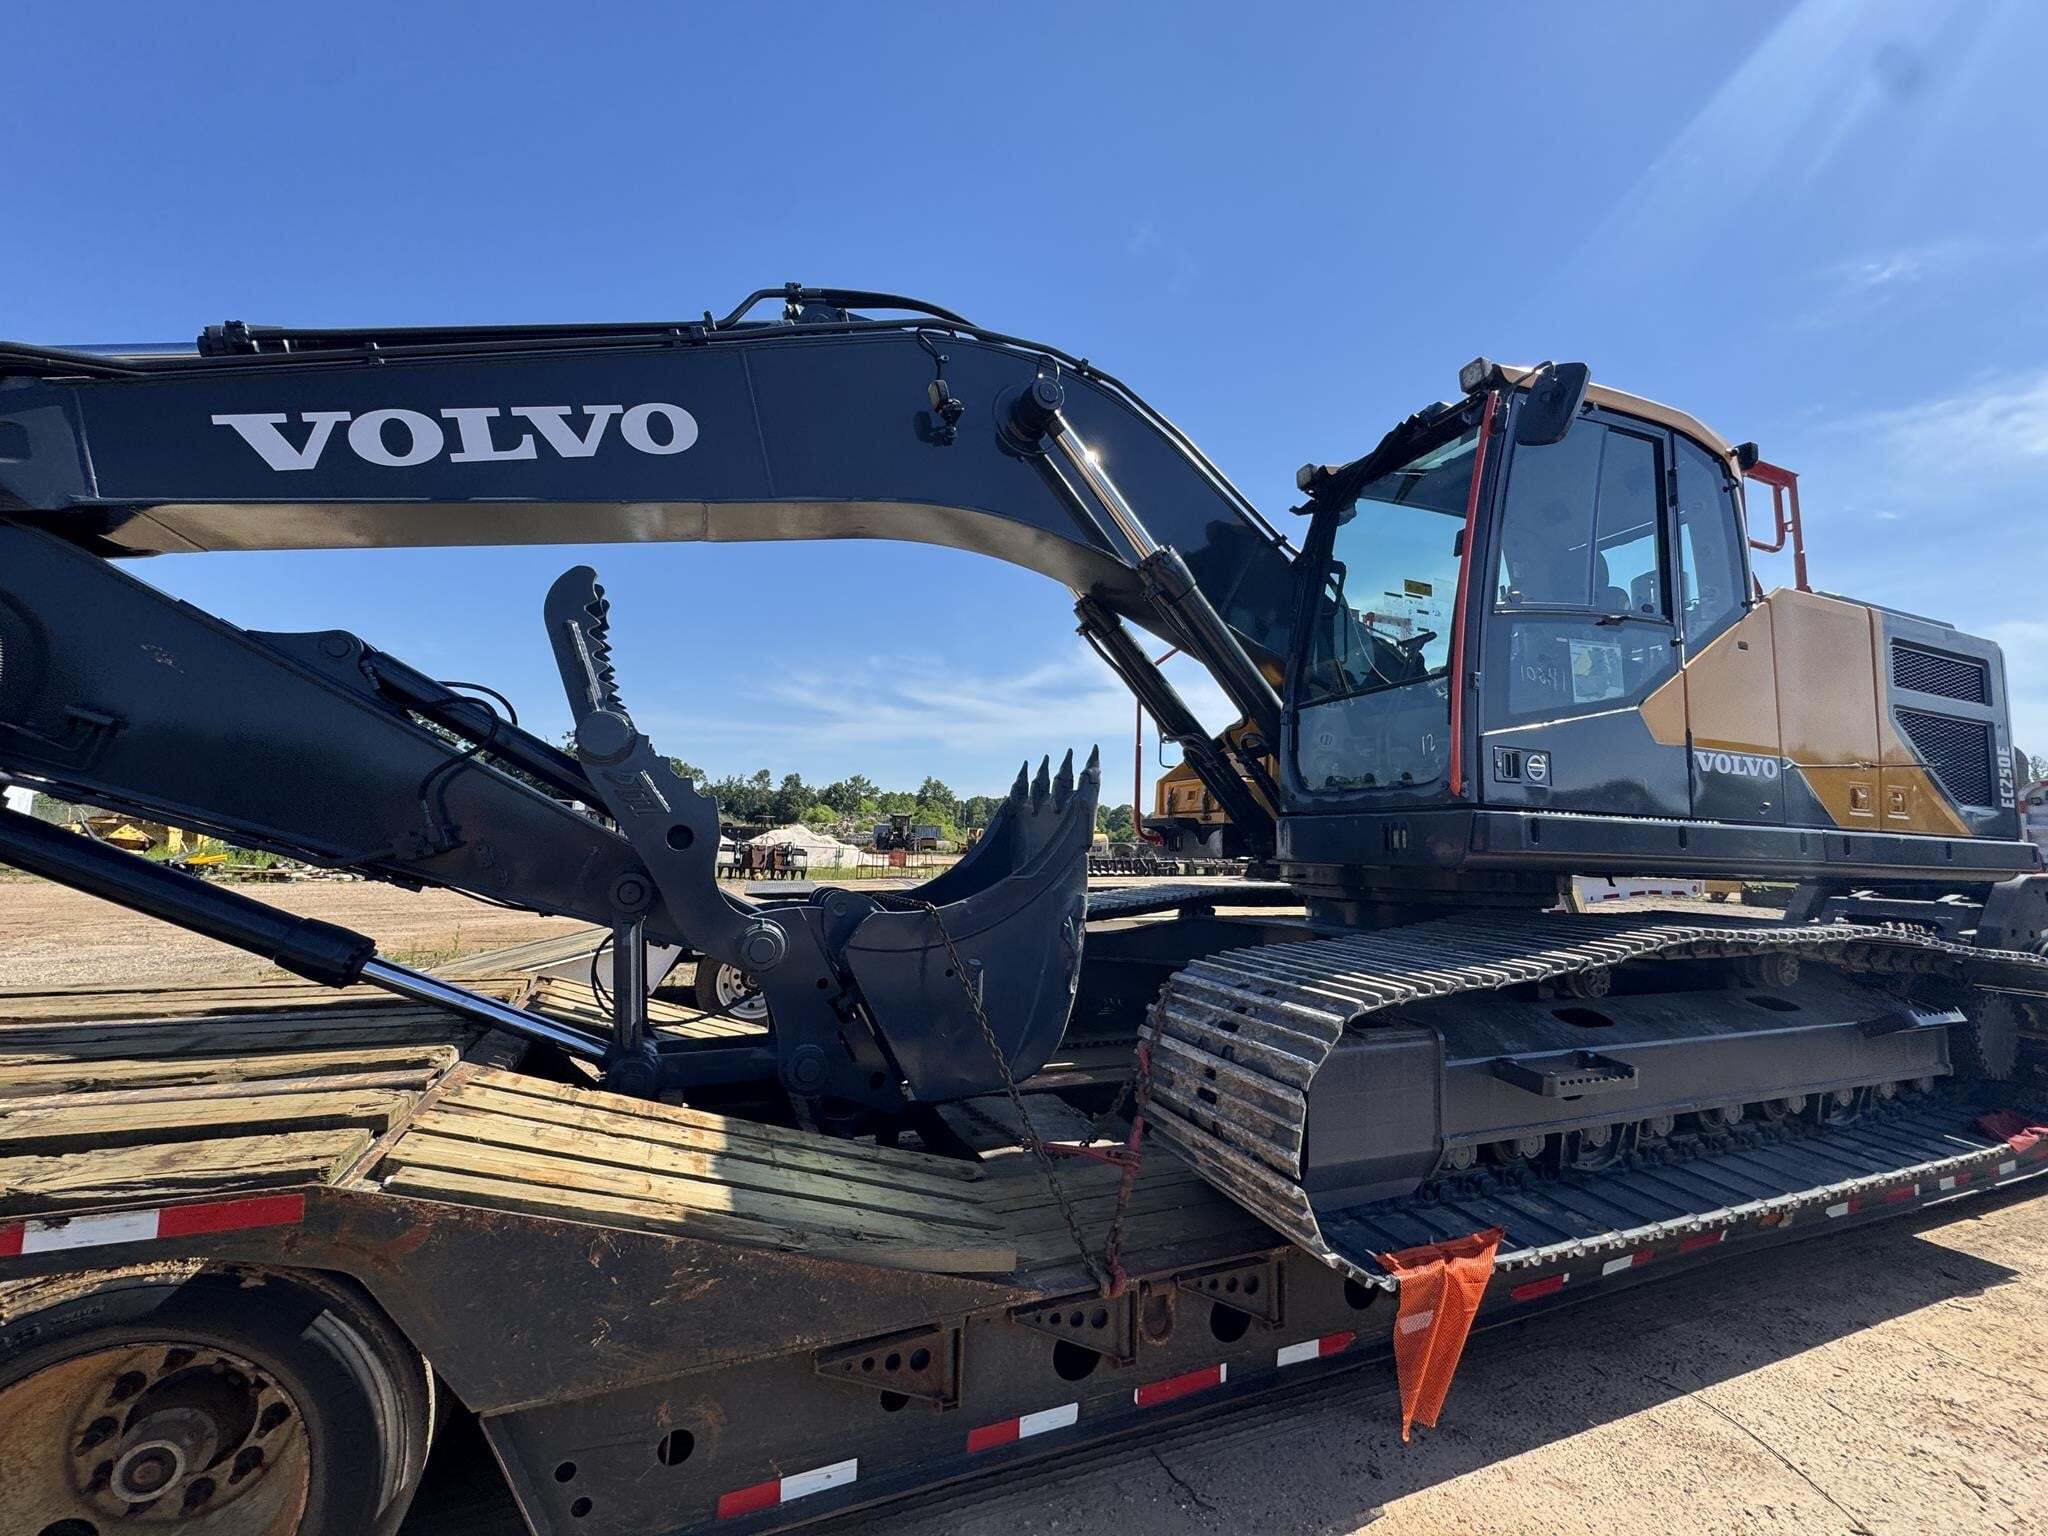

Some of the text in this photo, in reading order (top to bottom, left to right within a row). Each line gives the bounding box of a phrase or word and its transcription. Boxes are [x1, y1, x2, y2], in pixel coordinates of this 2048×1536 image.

[211, 402, 699, 471] VOLVO
[1694, 751, 1778, 779] VOLVO
[1997, 746, 2015, 810] EC250E
